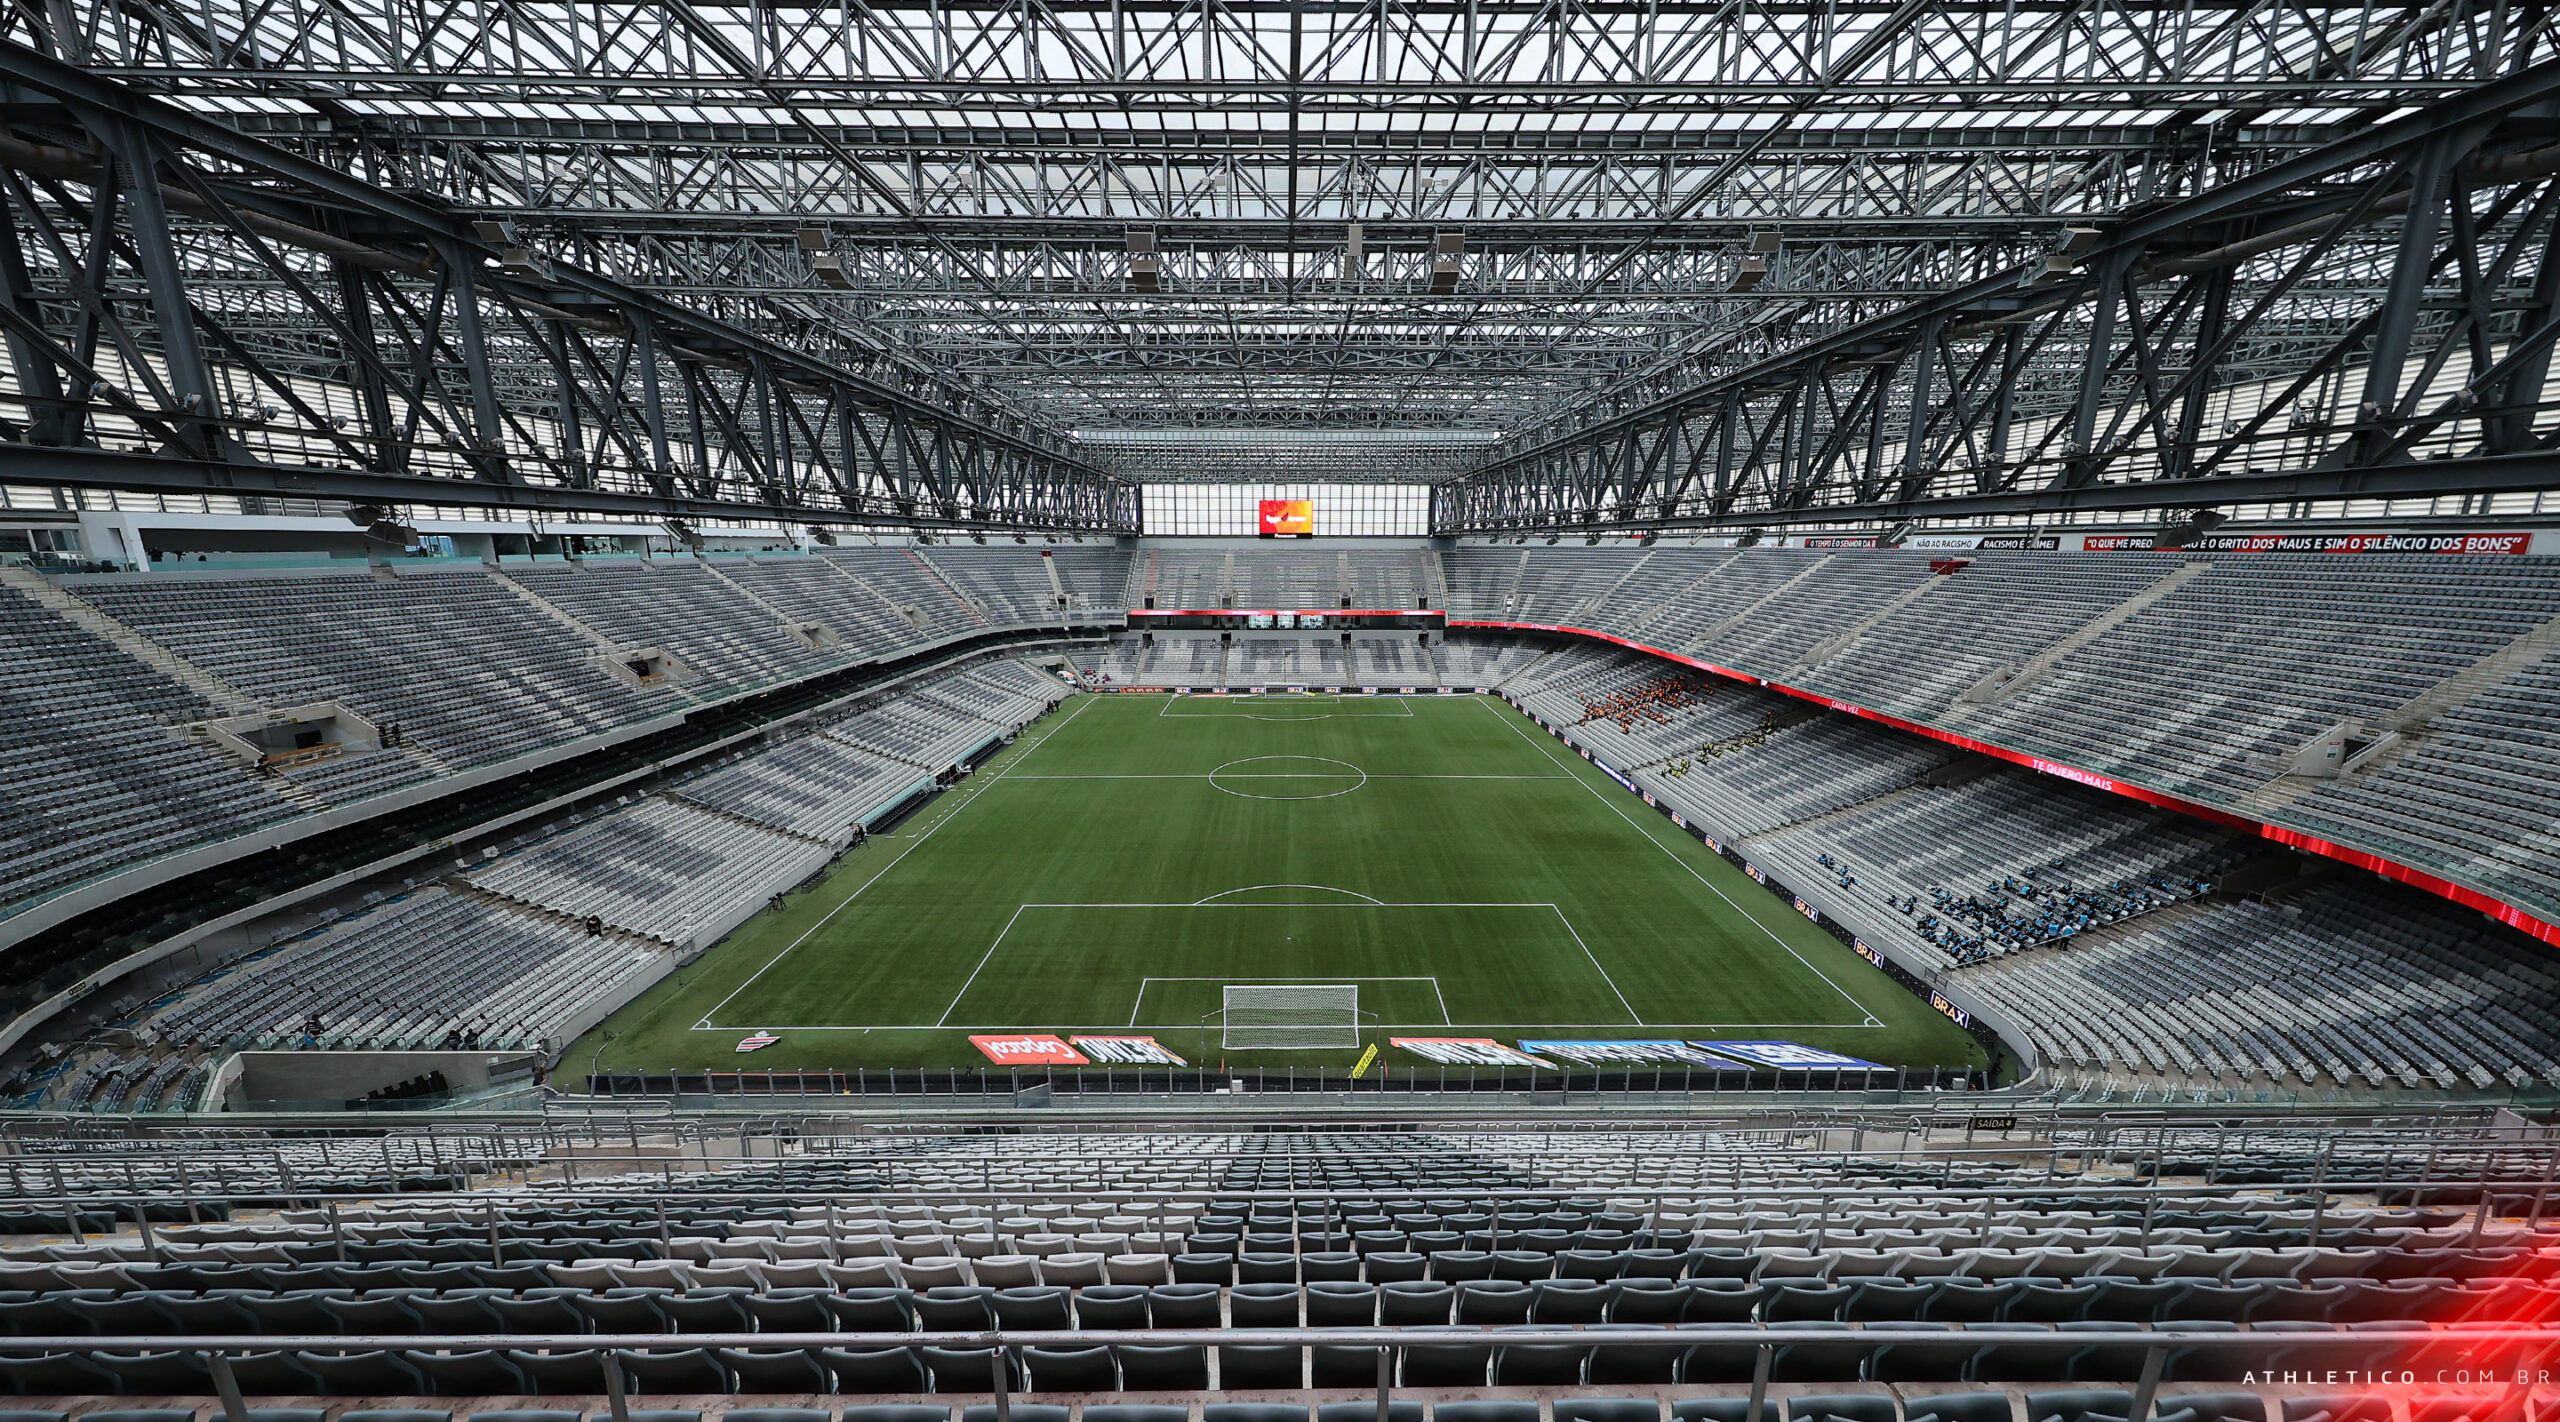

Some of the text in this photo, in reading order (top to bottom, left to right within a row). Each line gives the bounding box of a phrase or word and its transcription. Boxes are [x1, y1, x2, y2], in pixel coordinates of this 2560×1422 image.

[1917, 539, 1929, 547] NÃO
[1984, 540, 2017, 548] RACISMO
[2019, 538, 2024, 548] É
[2098, 539, 2115, 548] QUE
[2116, 539, 2128, 548] ME
[2209, 538, 2216, 548] O
[2218, 538, 2250, 549] GRITO
[2252, 538, 2274, 549] DOS
[2278, 537, 2311, 549] MAUS
[2314, 538, 2322, 549] E
[2324, 537, 2346, 549] SIM
[2351, 538, 2359, 549] O
[2362, 535, 2427, 550] SILÊNCIO
[2429, 537, 2463, 550] DOS
[1832, 700, 1858, 714] CADA VEZ
[2032, 759, 2112, 790] TE QUERO MAIS
[1747, 865, 1763, 883] BRAX
[1796, 900, 1816, 921] BRAX
[1856, 941, 1882, 967] BRAX
[1933, 995, 1965, 1026] BRAX
[982, 1038, 1077, 1059] Copacol
[1977, 1117, 2005, 1128] SAÍDA
